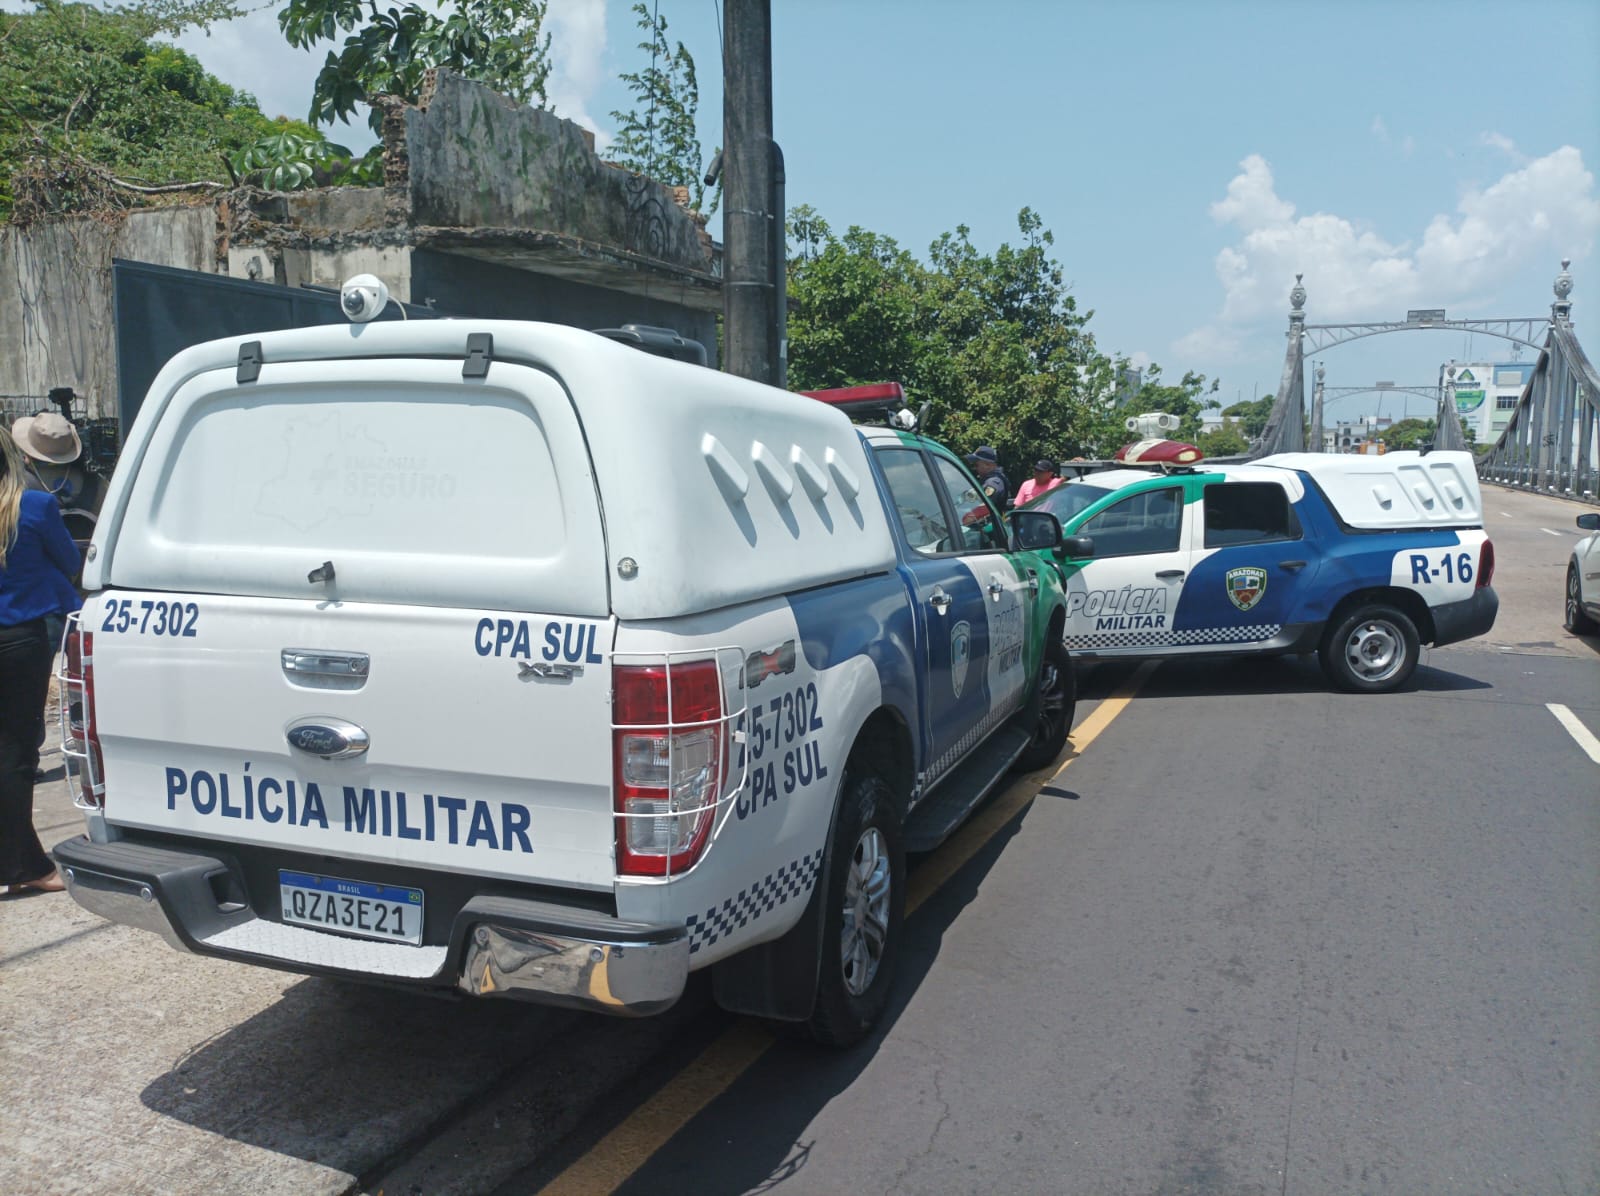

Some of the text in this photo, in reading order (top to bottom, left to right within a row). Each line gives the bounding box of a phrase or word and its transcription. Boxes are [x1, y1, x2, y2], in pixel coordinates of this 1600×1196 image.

[343, 471, 457, 500] SEGURO
[1410, 552, 1473, 585] R-16
[101, 598, 200, 638] 25-7302
[1065, 583, 1167, 618] POLÍCIA
[474, 617, 603, 664] CPA SUL
[1095, 615, 1166, 631] MILITAR
[297, 729, 334, 750] Ford
[735, 740, 828, 821] CPA SUL
[165, 761, 534, 854] POLÍCIA MILITAR
[337, 883, 361, 895] BRASIL
[293, 890, 405, 936] QZA3E21
